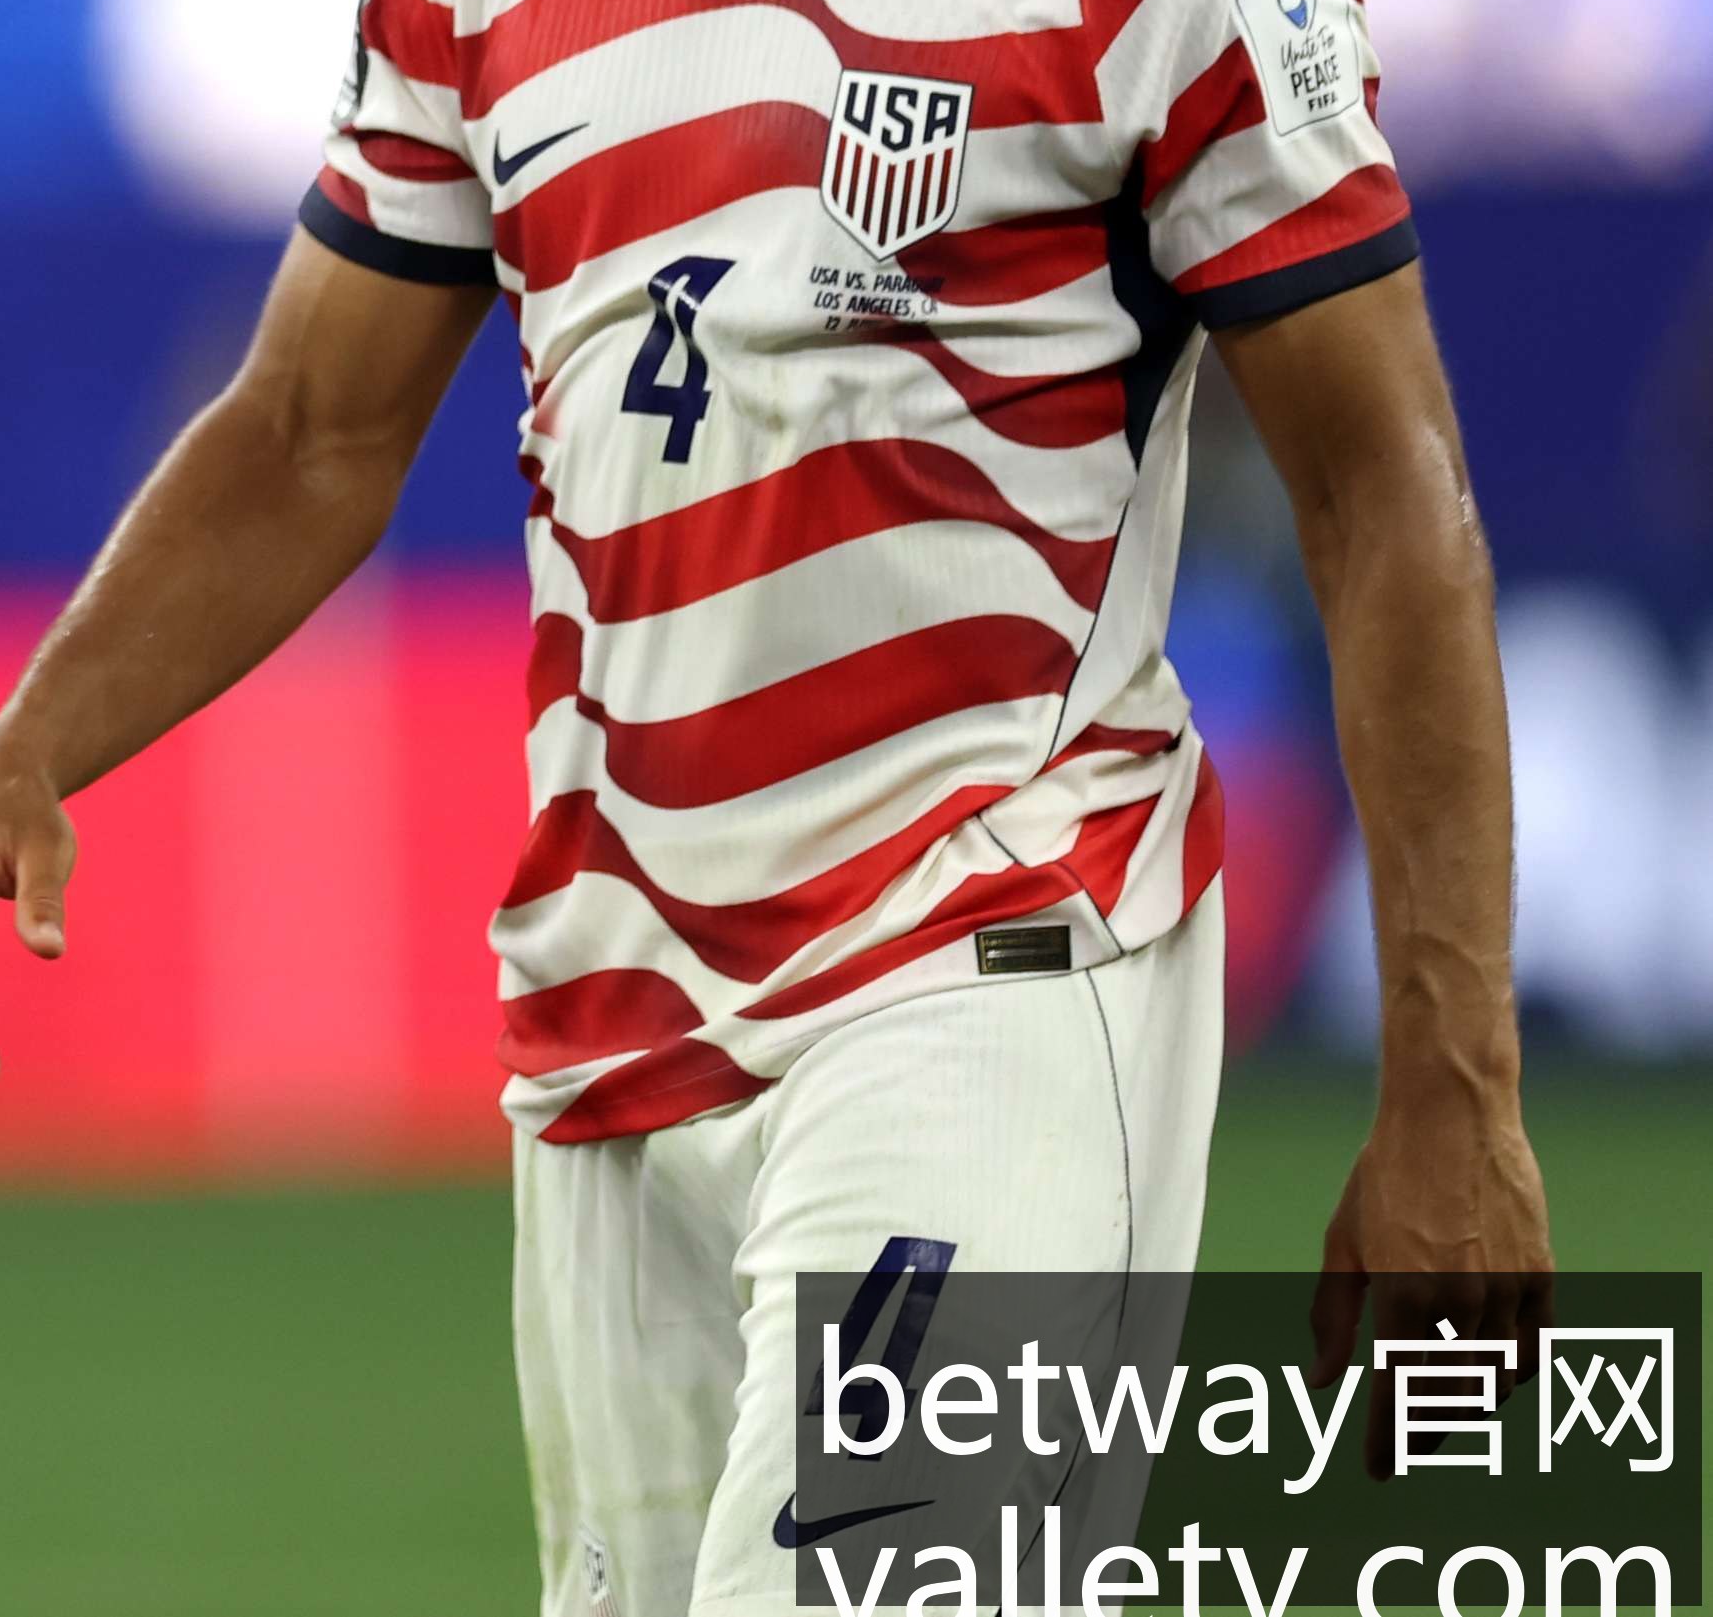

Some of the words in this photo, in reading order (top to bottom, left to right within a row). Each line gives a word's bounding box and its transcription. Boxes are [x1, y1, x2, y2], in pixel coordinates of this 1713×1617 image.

[1290, 53, 1341, 98] PEACE
[843, 82, 961, 152] USA
[810, 266, 840, 285] USA
[845, 271, 866, 290] VS.
[814, 291, 843, 310] LOS
[846, 295, 915, 319] ANGELES,
[621, 255, 737, 464] 4
